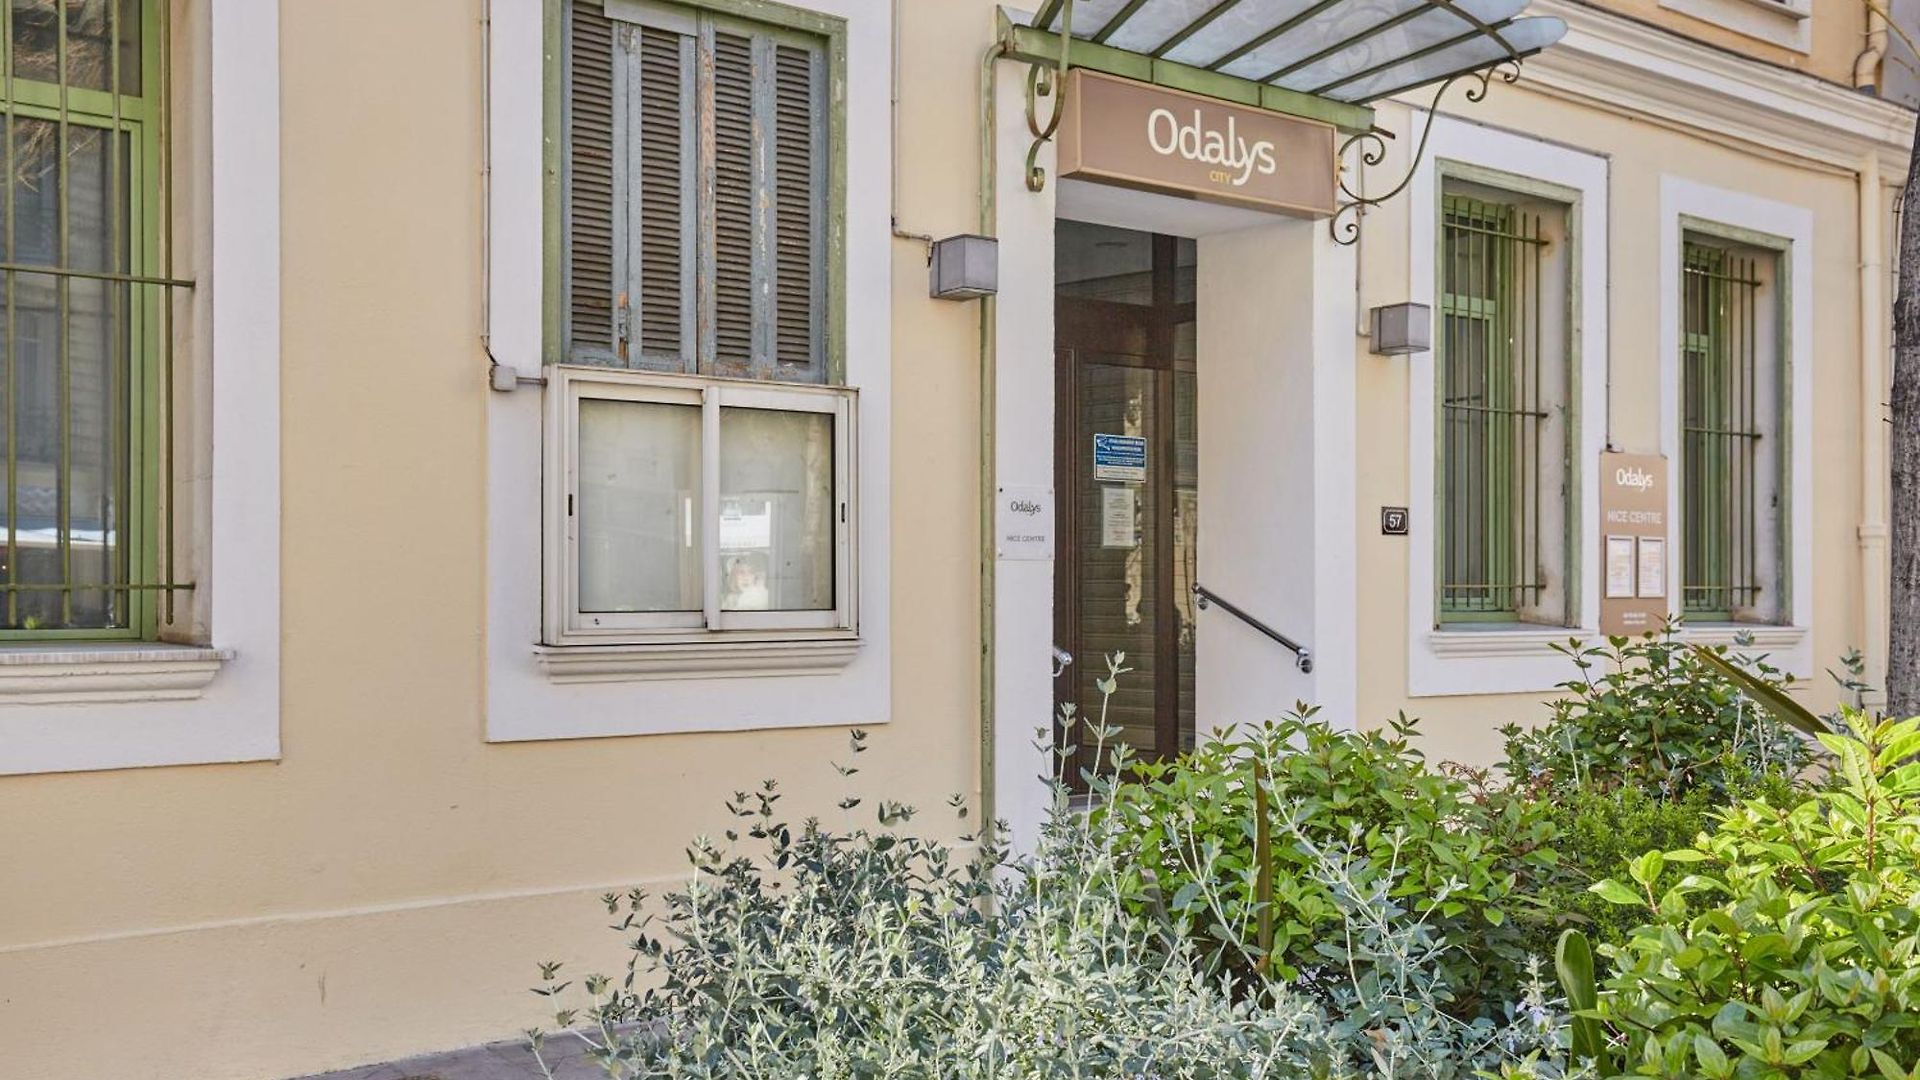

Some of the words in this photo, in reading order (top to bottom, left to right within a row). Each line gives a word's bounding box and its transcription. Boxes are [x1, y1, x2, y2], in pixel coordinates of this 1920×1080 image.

[1148, 108, 1276, 185] Odalys
[1209, 170, 1232, 183] CITY
[1616, 467, 1653, 492] Odalys
[1010, 500, 1041, 516] Odalys
[1389, 514, 1402, 528] 57
[1608, 510, 1628, 523] NICE
[1630, 511, 1662, 524] CENTRE
